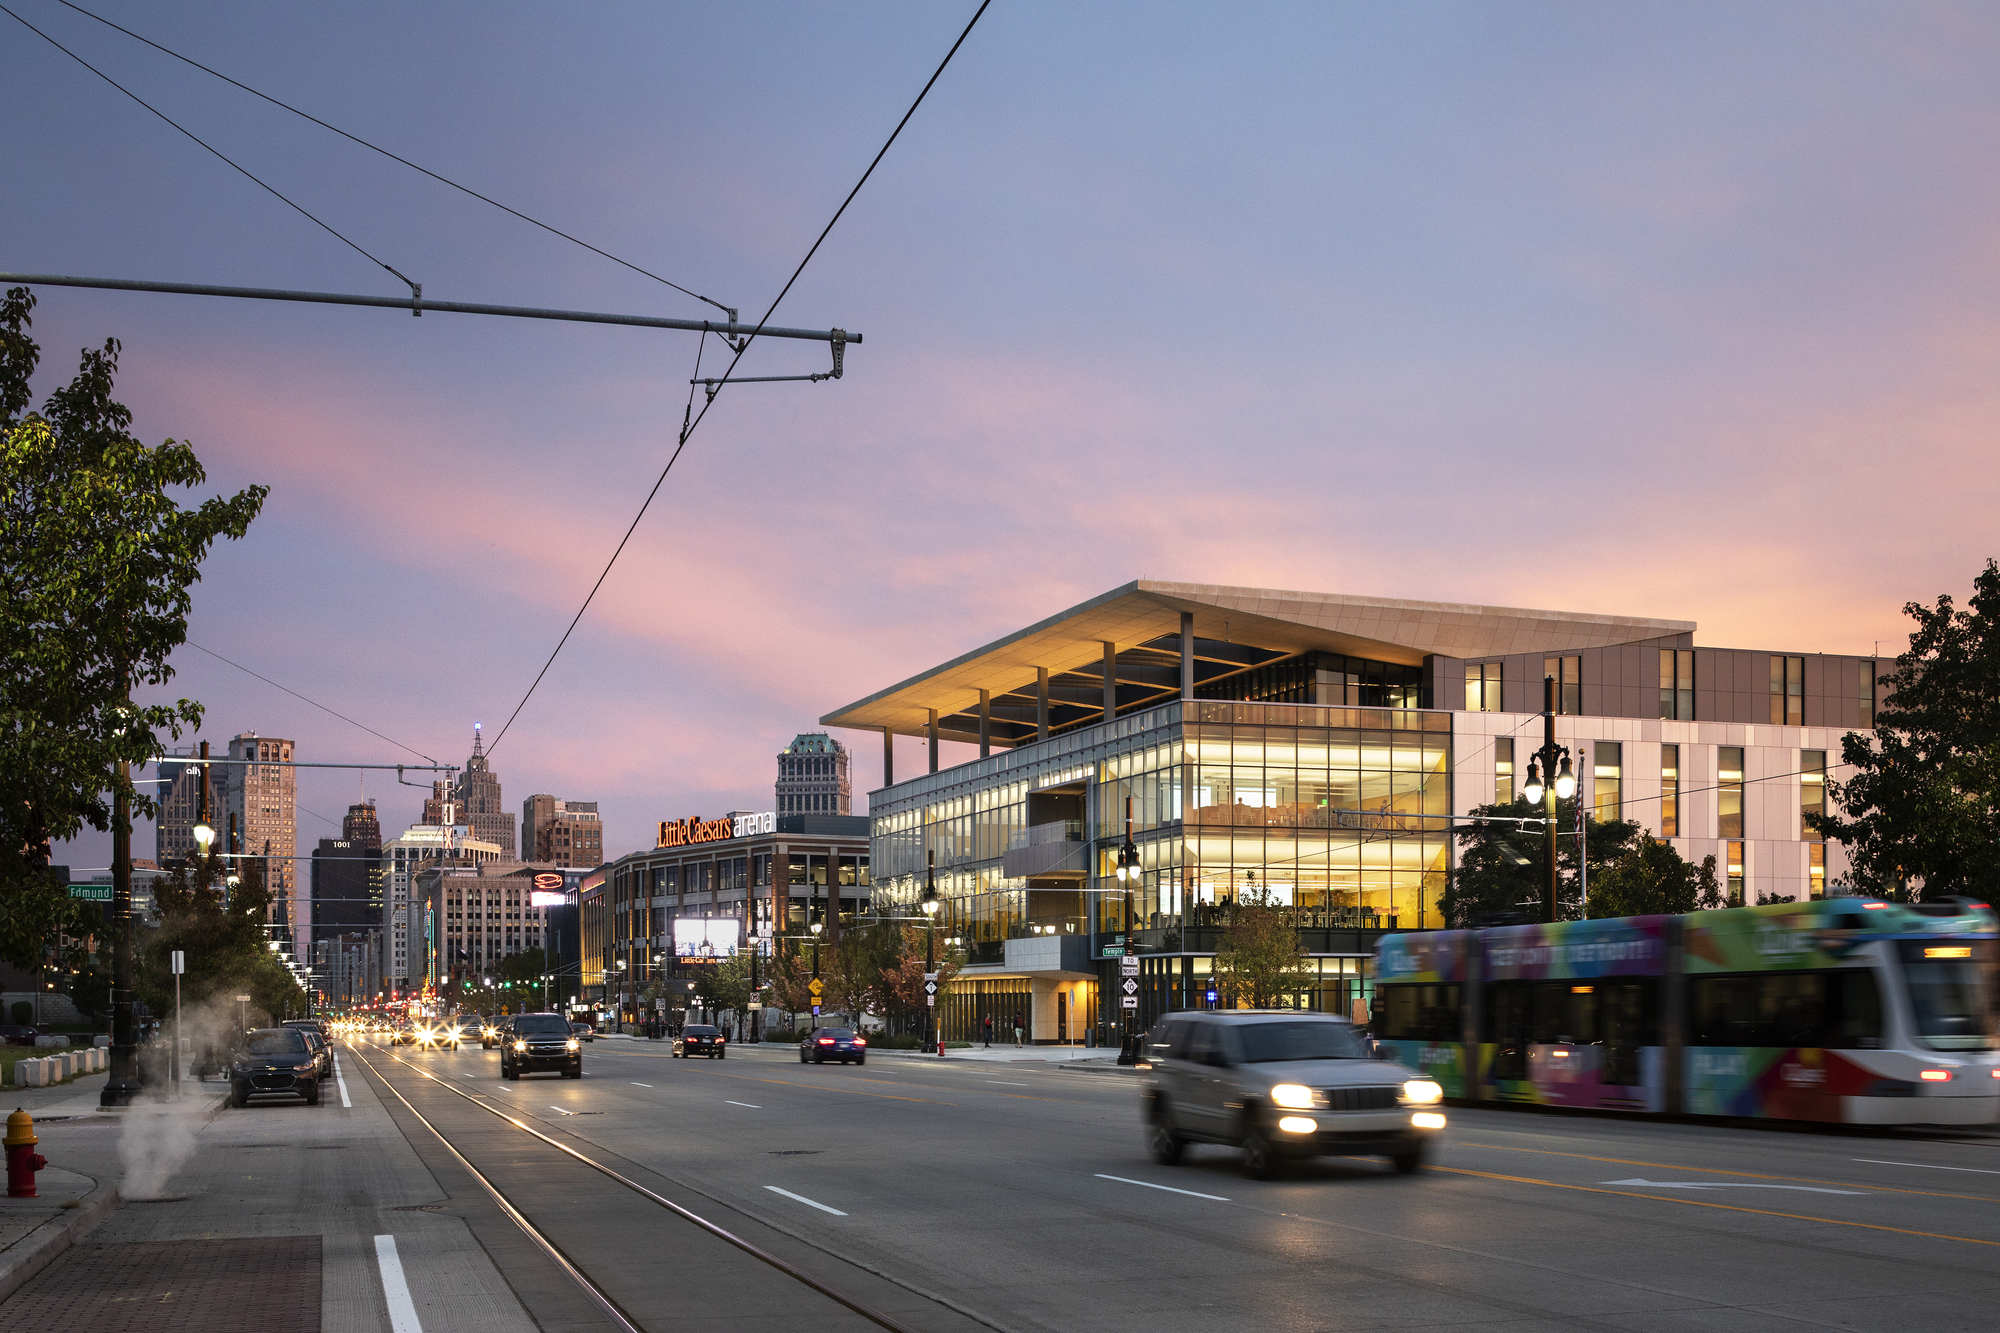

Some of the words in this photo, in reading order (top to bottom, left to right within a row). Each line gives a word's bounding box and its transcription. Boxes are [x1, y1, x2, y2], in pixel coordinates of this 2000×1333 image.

[185, 766, 201, 777] ally
[443, 778, 454, 850] FOX
[657, 817, 687, 849] Little
[687, 815, 732, 844] Caesars
[733, 811, 775, 838] arena
[70, 887, 110, 898] Edmund
[1105, 948, 1123, 956] Temple
[1127, 983, 1135, 991] 10
